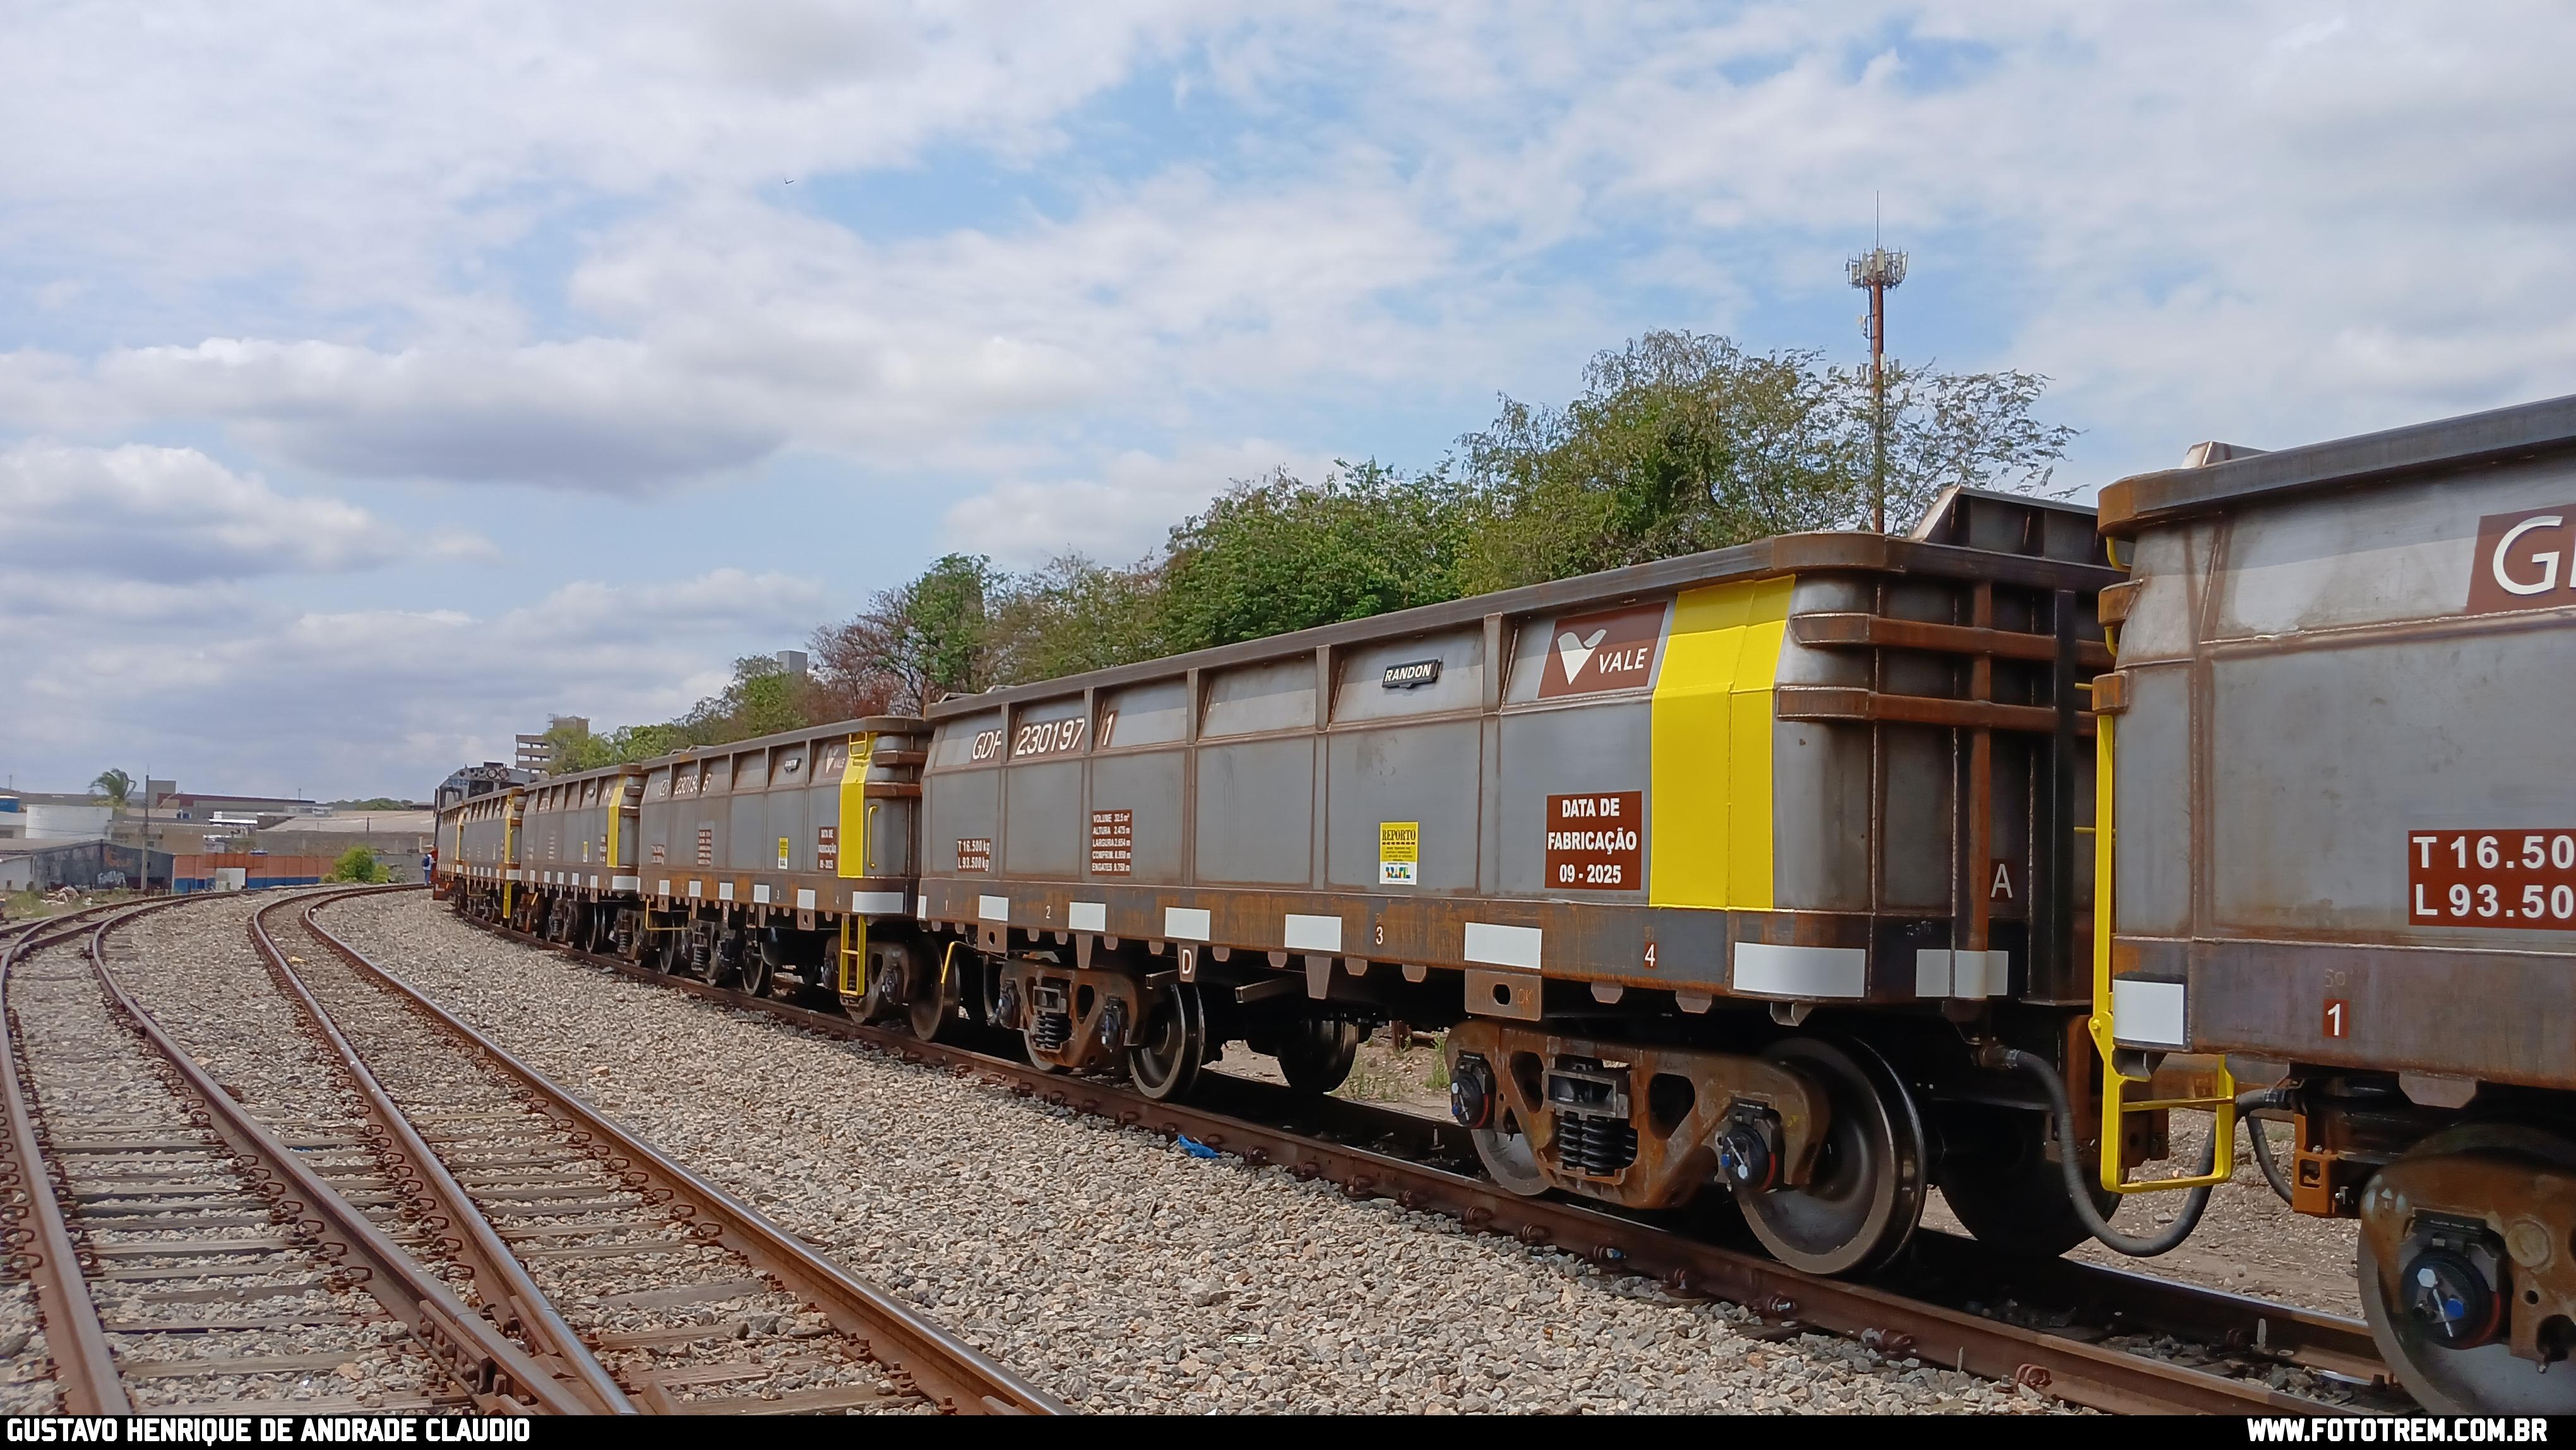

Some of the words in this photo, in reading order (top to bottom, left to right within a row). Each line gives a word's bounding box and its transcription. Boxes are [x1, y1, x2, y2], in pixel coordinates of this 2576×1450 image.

[2493, 515, 2576, 595] G
[1599, 647, 1648, 674] VALE
[1385, 664, 1432, 682] RANDON
[1015, 718, 1085, 755] 230197
[1103, 713, 1114, 746] 1
[1562, 798, 1596, 817] DATA
[1600, 798, 1620, 817] DE
[957, 840, 962, 853] T
[1381, 829, 1416, 841] REPORTO
[1547, 827, 1637, 854] FABRICAÇÃO
[958, 856, 962, 869] L
[2412, 836, 2438, 869] T
[1559, 864, 1575, 883] 09
[1587, 864, 1621, 884] 2025
[1991, 863, 2013, 898] A
[1046, 905, 1051, 919] 2
[2416, 884, 2438, 916] L
[1376, 926, 1383, 945] 3
[1182, 949, 1192, 974] D
[1645, 944, 1655, 967] 4
[2327, 1003, 2340, 1036] 1
